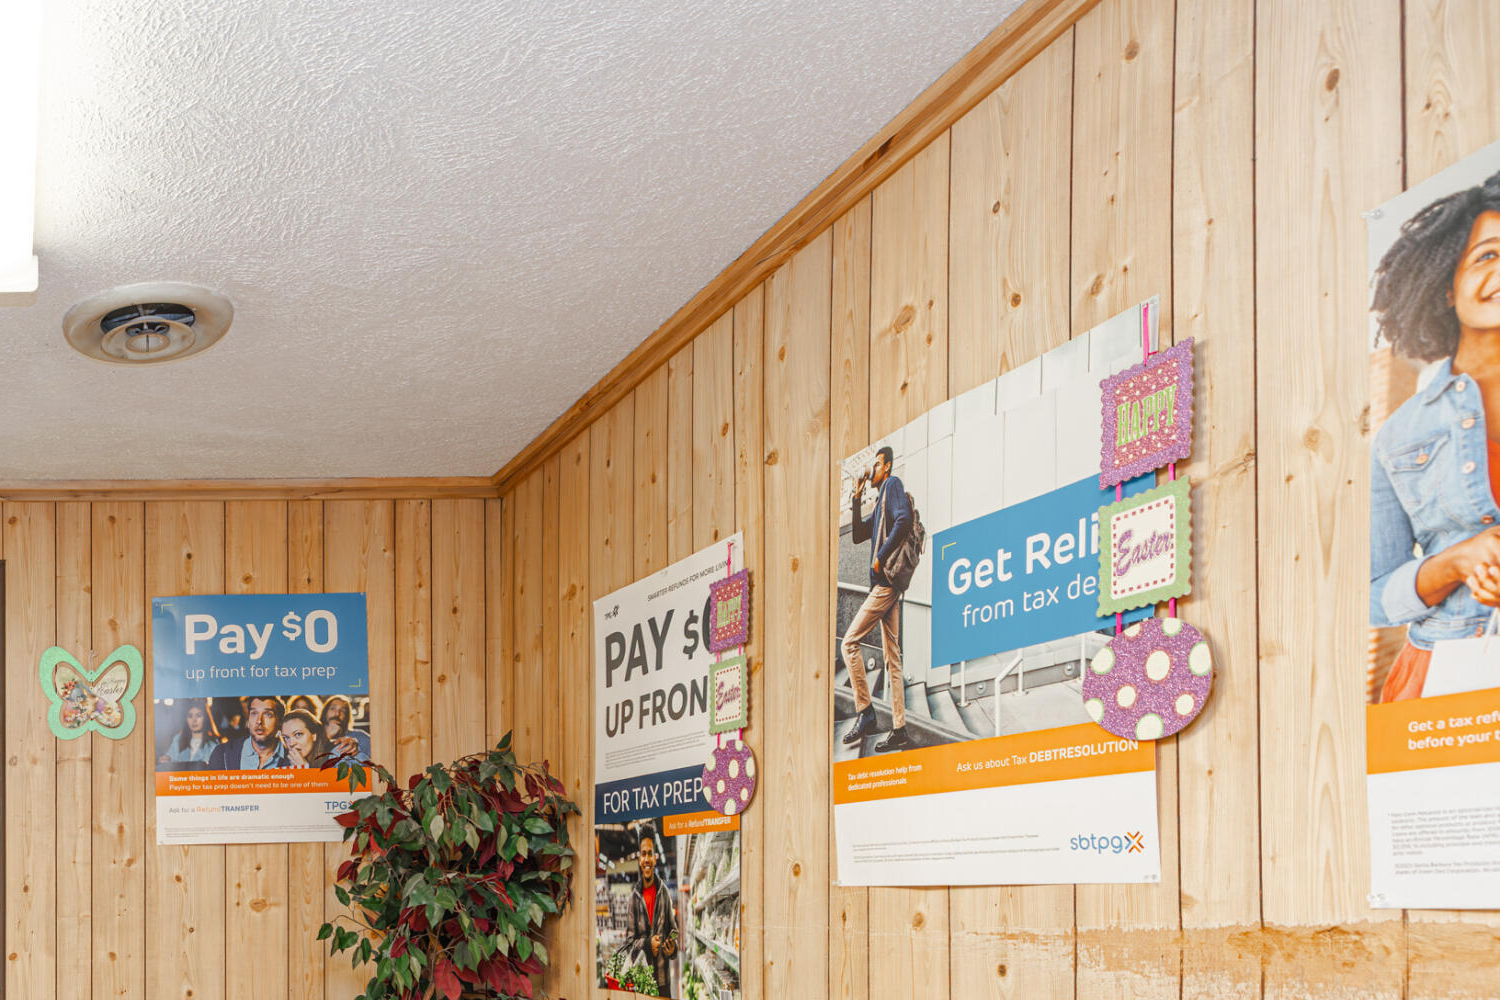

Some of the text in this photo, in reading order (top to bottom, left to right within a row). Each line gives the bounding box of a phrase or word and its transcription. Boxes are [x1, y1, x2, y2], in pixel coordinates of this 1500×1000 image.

[1116, 383, 1177, 447] HAPPY
[948, 511, 1100, 596] Get Reli
[1115, 529, 1171, 577] Easter
[962, 573, 1097, 628] from tax de
[184, 609, 338, 660] Pay $0
[605, 608, 675, 689] PAY
[186, 667, 205, 681] up
[210, 665, 245, 679] front
[251, 664, 270, 678] for
[275, 666, 298, 678] tax
[605, 675, 708, 738] UP FRON
[1408, 720, 1434, 733] Get
[1436, 720, 1445, 730] a
[1448, 715, 1473, 728] tax
[956, 739, 1139, 772] Ask us about Tax DEBTRESOLUTION
[1408, 734, 1454, 750] before
[1457, 731, 1492, 748] your
[603, 777, 703, 815] FOR TAX PREP
